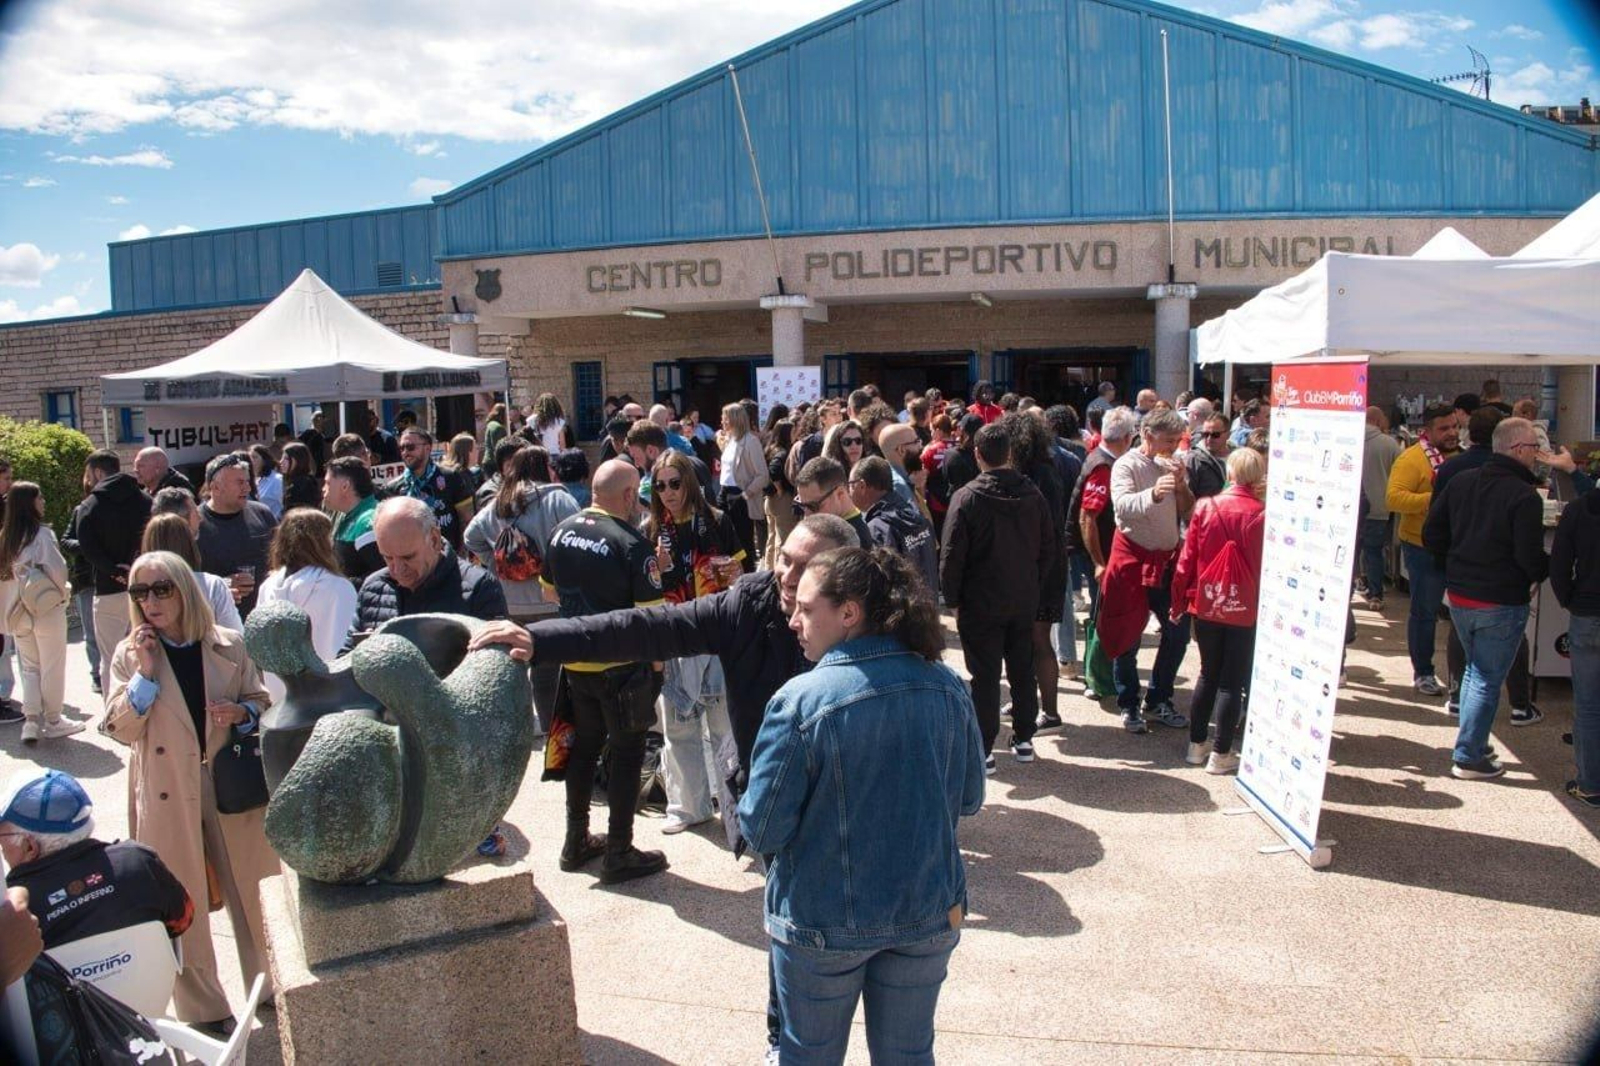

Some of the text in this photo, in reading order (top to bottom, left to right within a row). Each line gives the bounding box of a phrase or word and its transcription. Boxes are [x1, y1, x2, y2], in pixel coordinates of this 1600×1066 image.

[586, 258, 722, 293] CENTRO
[804, 239, 1118, 282] POLIDEPORTIVO
[148, 421, 270, 450] TUBULART
[550, 529, 610, 557] A Guarda
[69, 900, 78, 908] O
[78, 884, 115, 905] INFERNO
